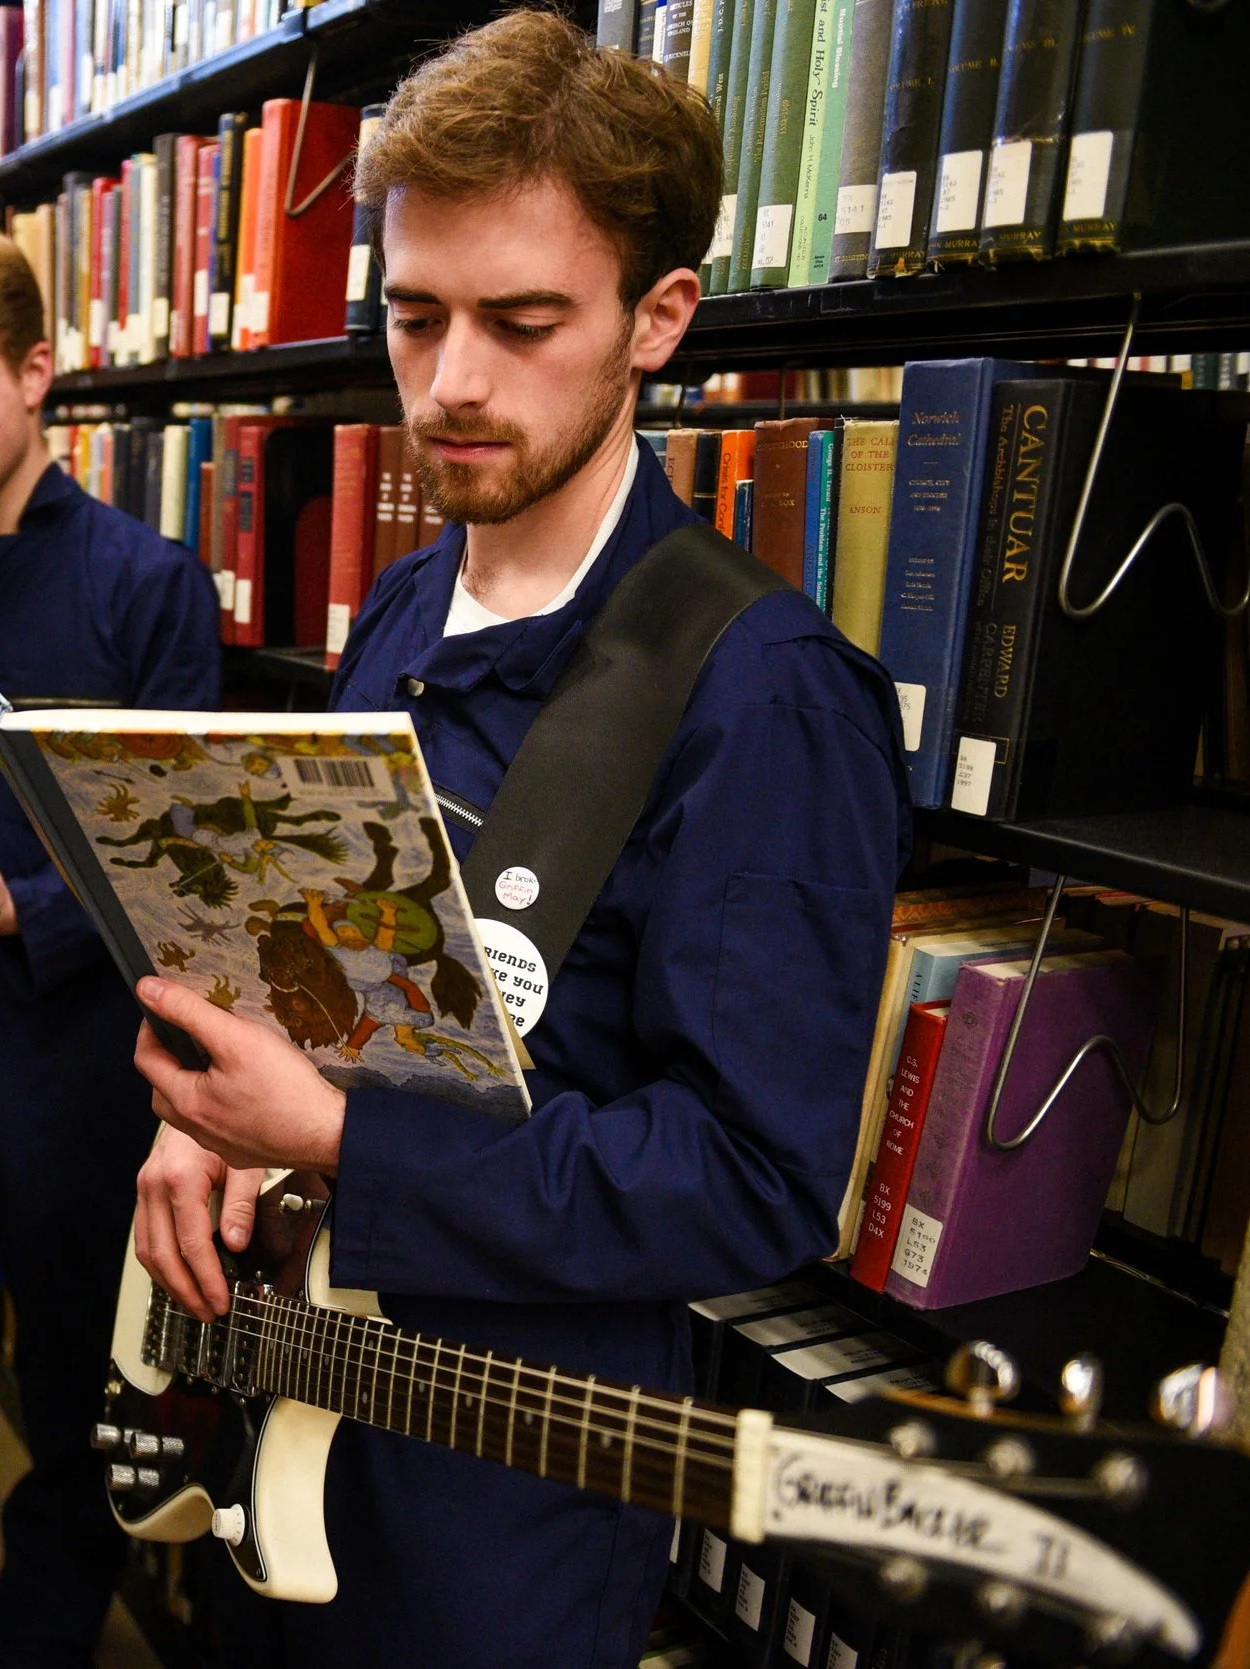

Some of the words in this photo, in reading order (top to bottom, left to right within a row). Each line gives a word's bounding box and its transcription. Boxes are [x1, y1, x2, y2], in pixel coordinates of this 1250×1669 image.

[820, 0, 831, 12] ist
[816, 19, 826, 43] and
[835, 8, 847, 46] Nuptial
[813, 49, 825, 87] Holy
[831, 46, 843, 89] Blessing
[809, 89, 824, 127] Spirit
[803, 164, 814, 200] McKenna
[818, 213, 828, 222] 64
[999, 230, 1042, 241] MURRAY
[911, 411, 962, 425] Norwich
[1000, 404, 1013, 432] The
[846, 437, 866, 447] THE
[907, 431, 962, 447] Cathedral
[826, 443, 834, 466] George
[850, 450, 864, 460] OF
[868, 450, 890, 460] THE
[722, 451, 732, 484] Crisis
[844, 463, 895, 473] CLOISTER
[989, 438, 1008, 516] Archbishops
[1002, 403, 1048, 584] CANTUAR
[717, 501, 728, 531] Conf
[848, 505, 882, 515] ANSON
[818, 523, 826, 552] Problem
[994, 623, 1017, 698] EDWARD
[973, 622, 998, 722] CARPENTER
[502, 870, 513, 881] I
[498, 880, 534, 893] Griffin
[512, 974, 544, 995] you
[901, 1067, 920, 1084] LEWIS
[899, 1084, 914, 1097] AND
[898, 1099, 910, 1112] THE
[889, 1109, 915, 1129] CHURCH
[892, 1128, 902, 1138] OF
[885, 1139, 905, 1155] ROME
[879, 1182, 891, 1196] BX
[873, 1194, 892, 1212] 5199
[872, 1208, 887, 1225] L53
[912, 1216, 925, 1230] BX
[868, 1222, 885, 1239] D4X
[906, 1237, 927, 1253] L53
[904, 1247, 925, 1263] G73
[902, 1258, 928, 1275] 1974
